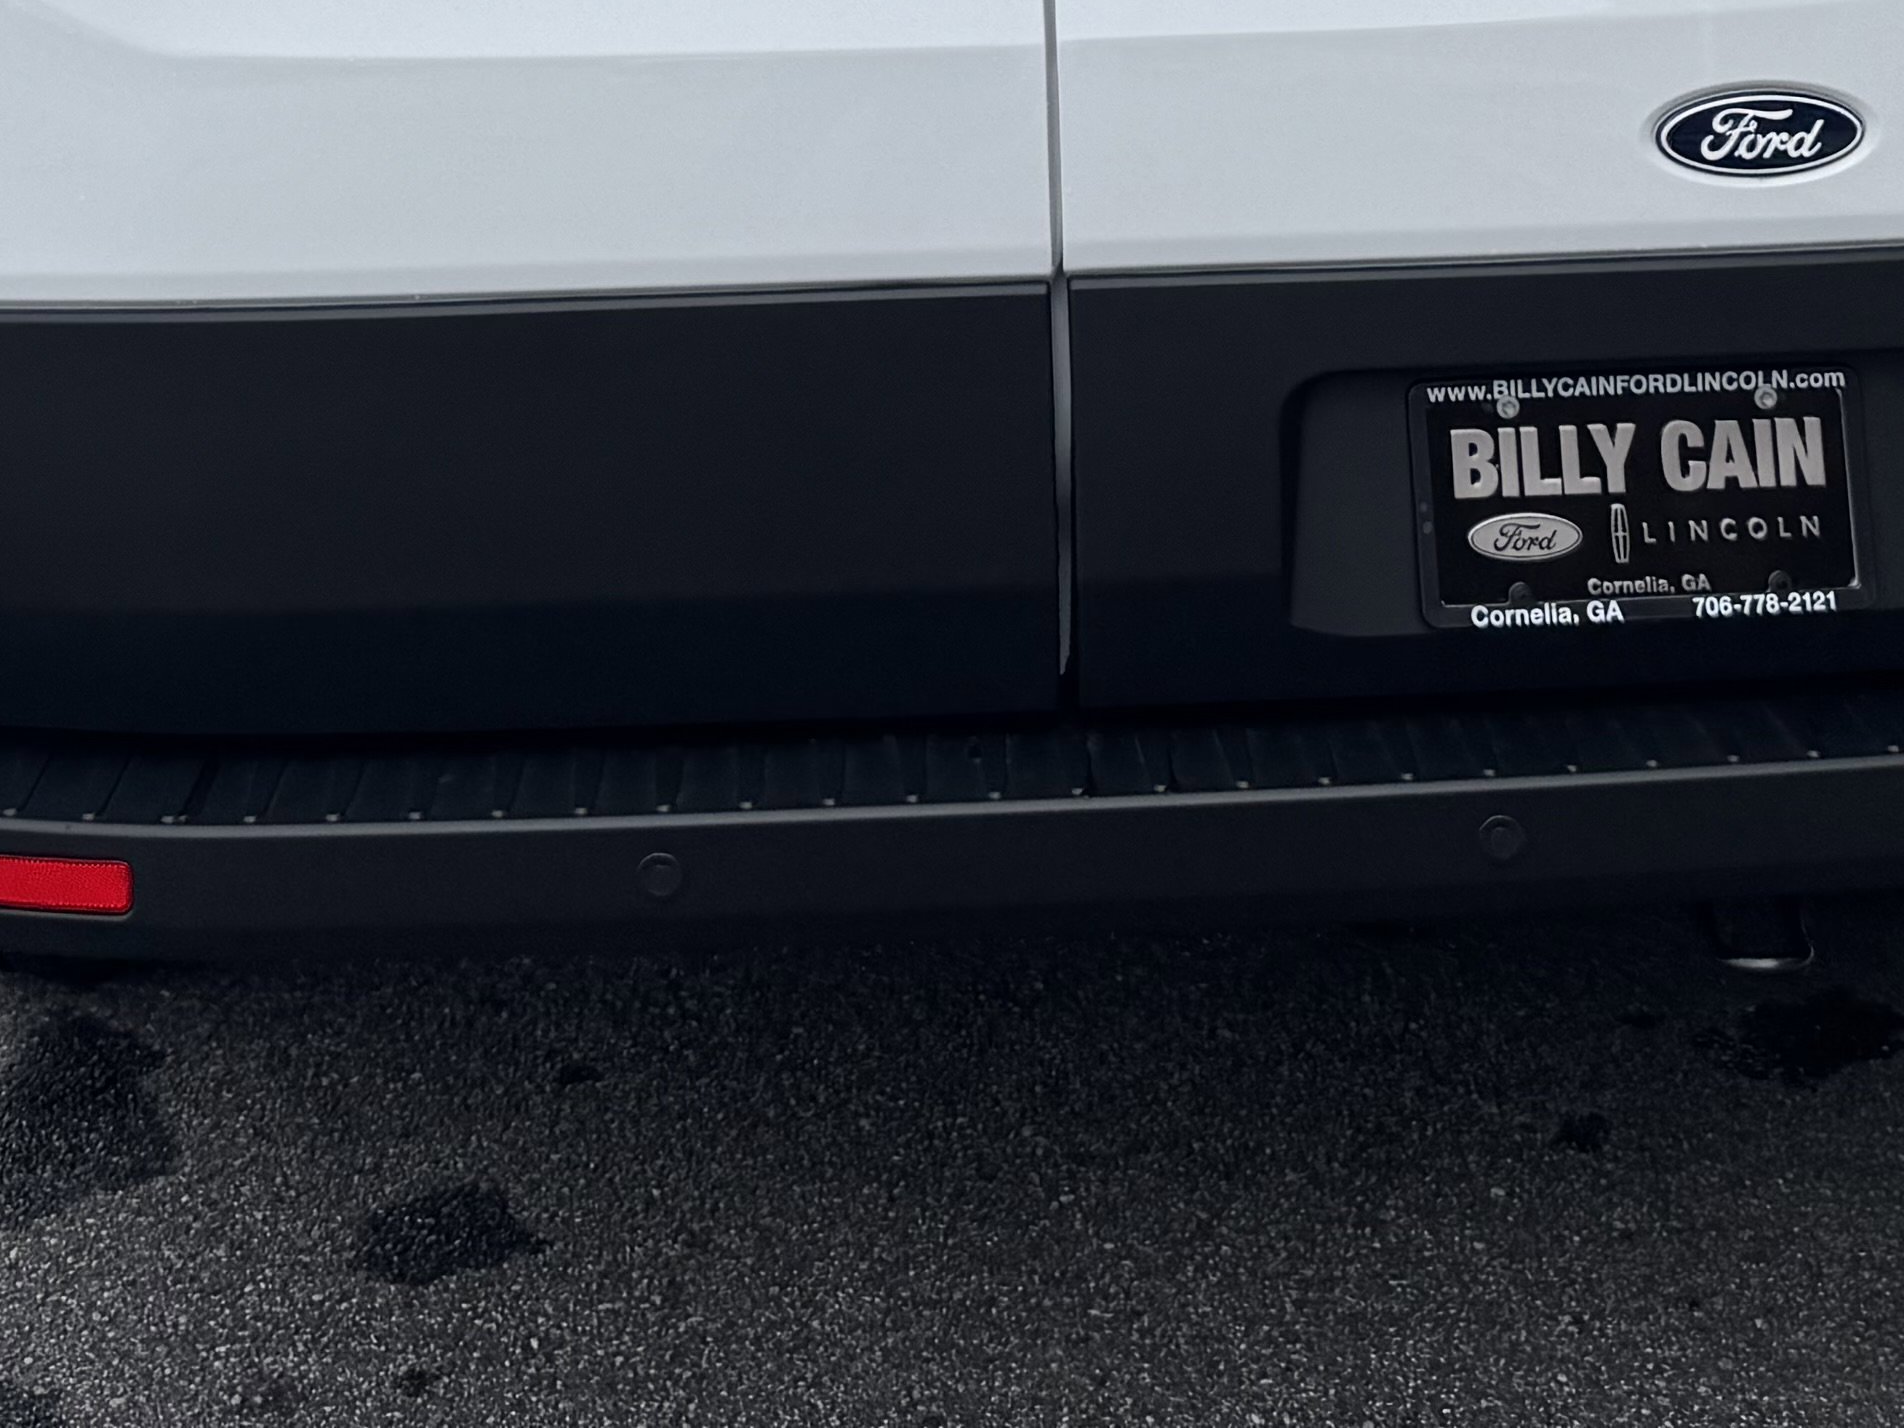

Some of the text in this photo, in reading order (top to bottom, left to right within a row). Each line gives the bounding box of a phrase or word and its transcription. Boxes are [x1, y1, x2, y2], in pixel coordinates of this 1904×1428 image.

[1700, 107, 1825, 161] Ford
[1426, 369, 1846, 403] www.BILLYCAINFORDLINCOLN.com
[1449, 416, 1827, 499] BILLY CAIN
[1641, 514, 1821, 545] LINCOLN
[1587, 572, 1712, 597] Cornelia, GA
[1470, 590, 1838, 628] Cornelia, GA 706-778-2121
